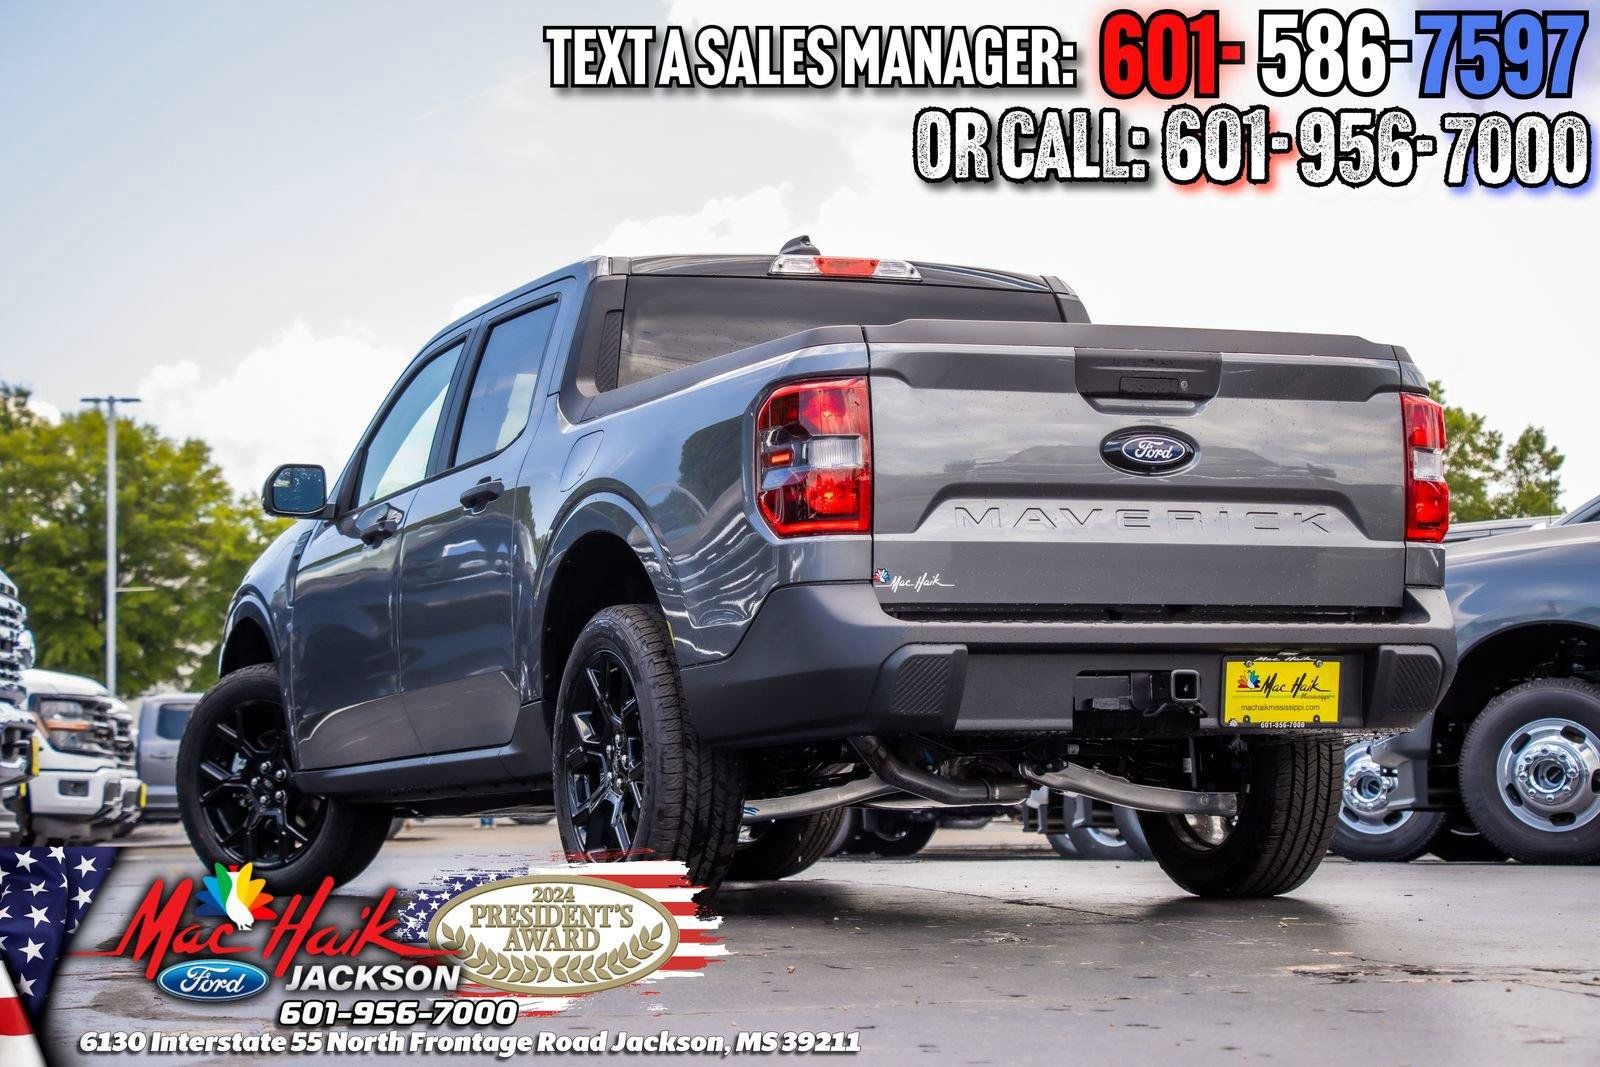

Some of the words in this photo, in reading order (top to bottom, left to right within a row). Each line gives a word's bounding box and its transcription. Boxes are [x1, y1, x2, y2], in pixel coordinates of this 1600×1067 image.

[1133, 439, 1174, 460] Ford
[954, 506, 1331, 534] MAVERICK
[889, 575, 914, 593] Mac
[914, 572, 952, 593] Haik
[1260, 672, 1286, 698] Mac
[1291, 672, 1327, 698] Haik
[1240, 704, 1320, 712] machaikmississippi.com
